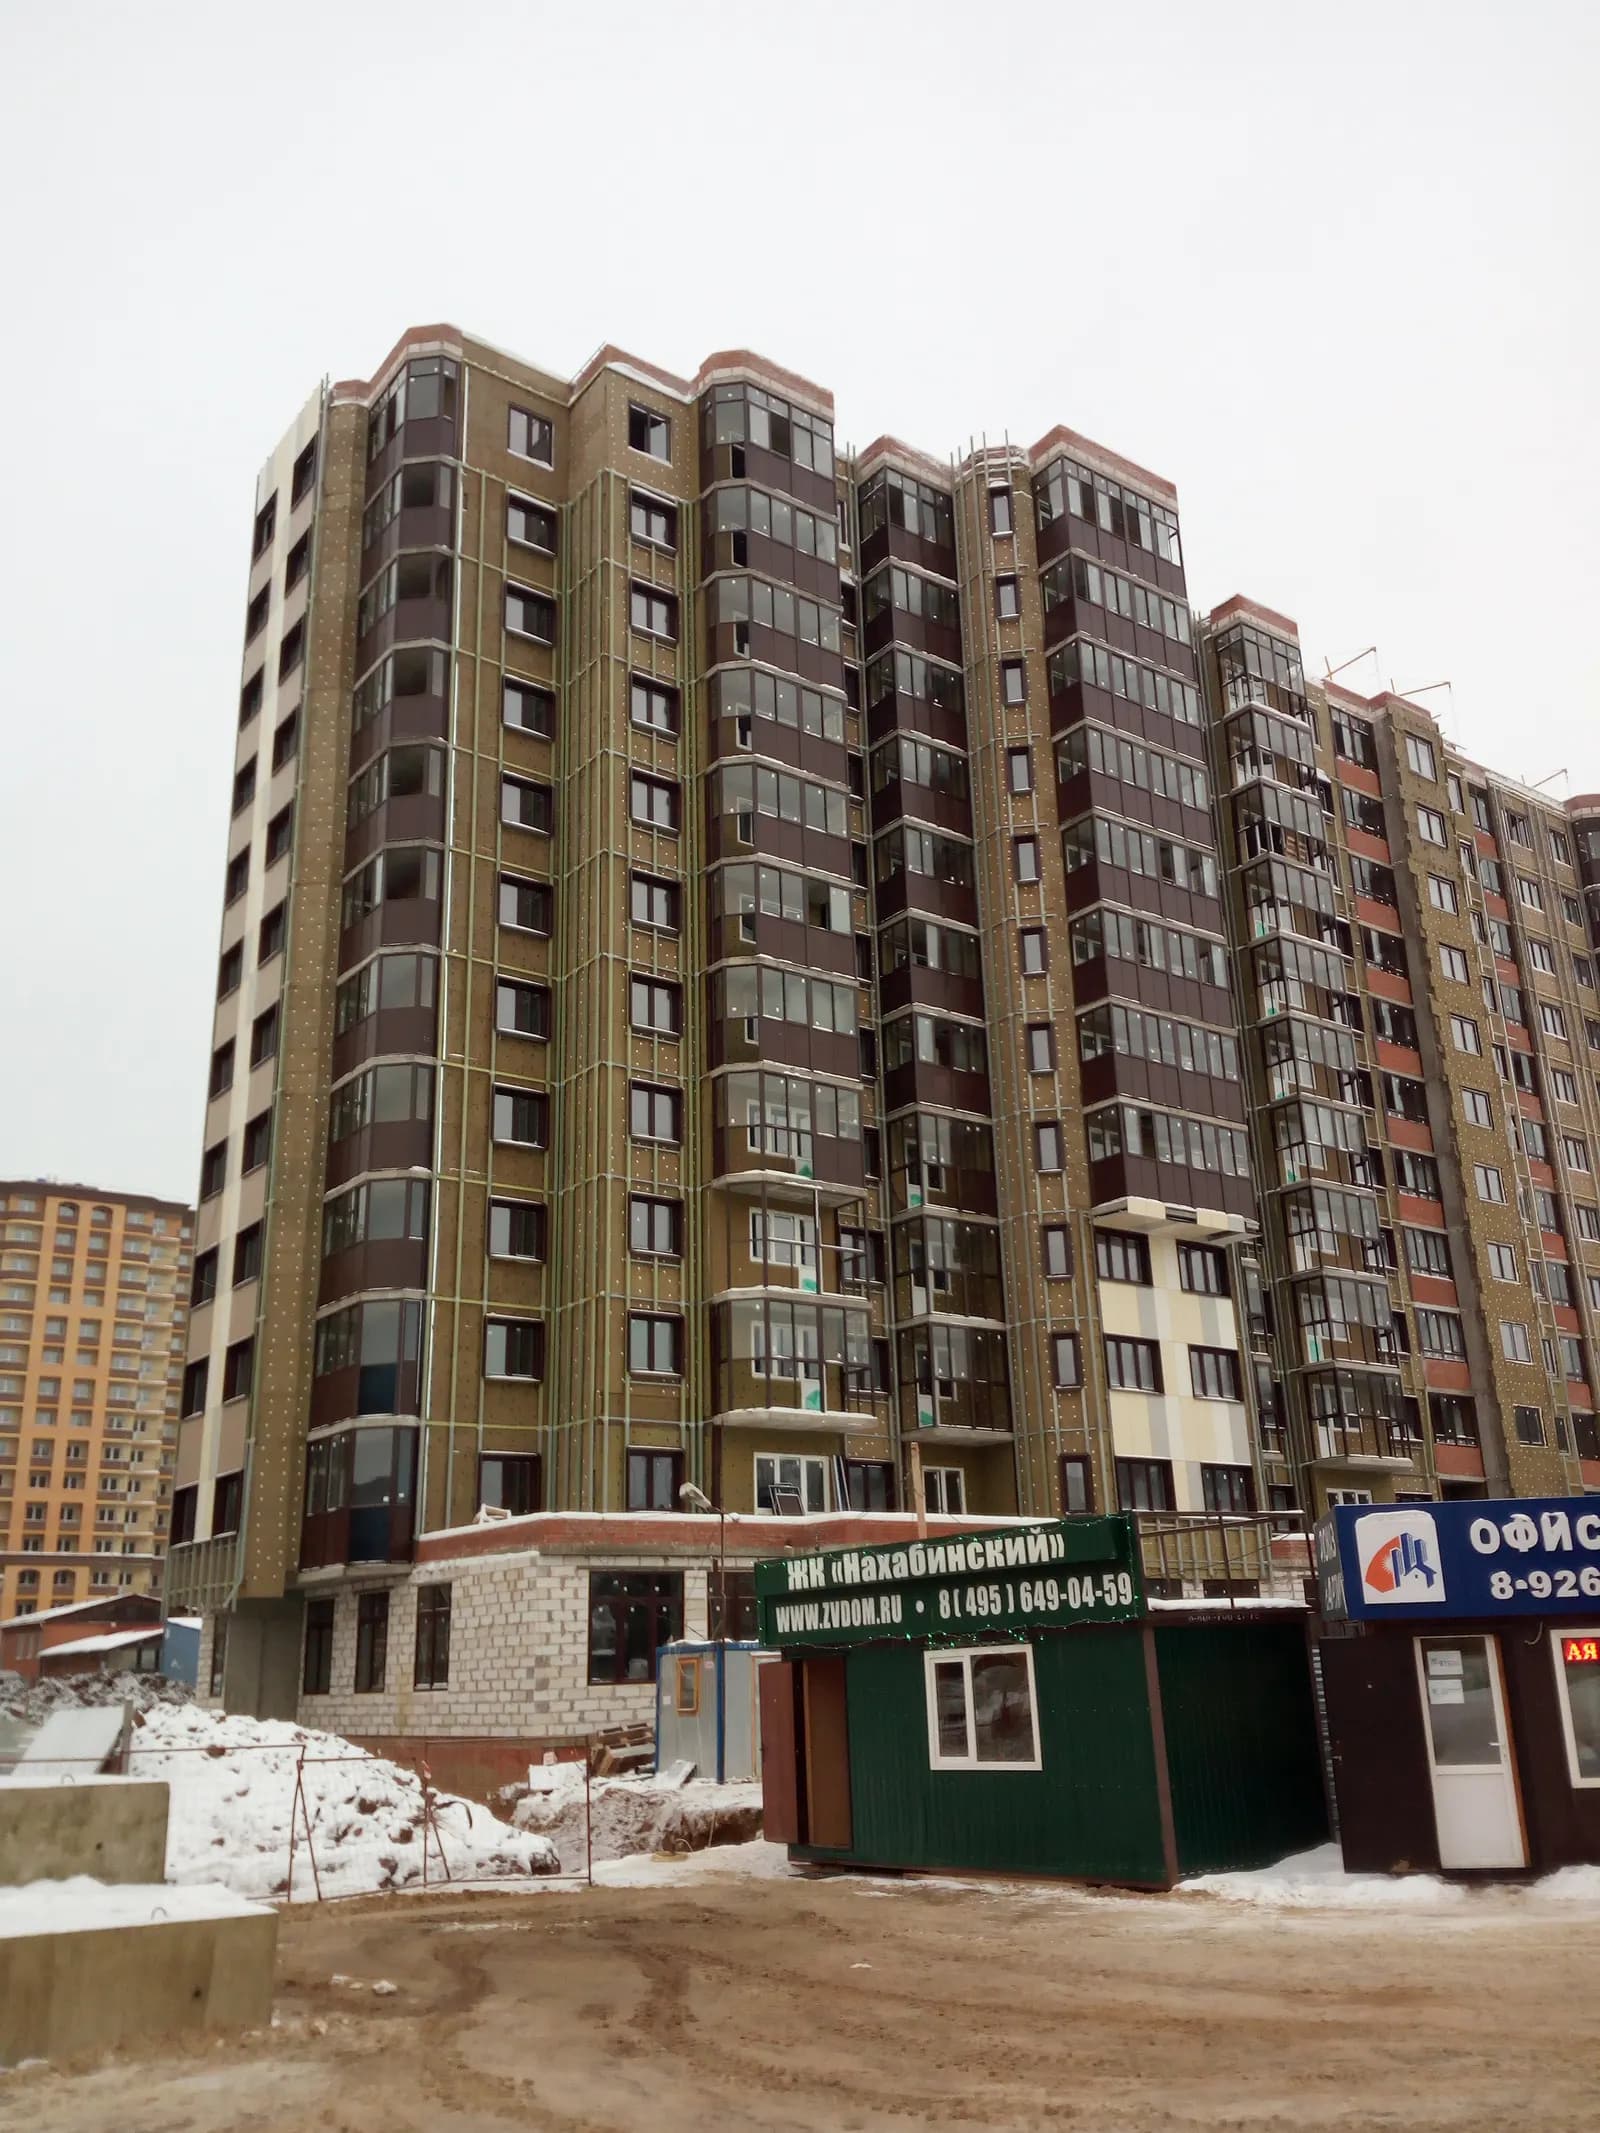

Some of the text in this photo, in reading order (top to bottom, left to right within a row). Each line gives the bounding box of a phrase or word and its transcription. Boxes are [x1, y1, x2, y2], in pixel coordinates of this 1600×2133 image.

[787, 1527, 1064, 1590] ЖК «Нахабинский»
[776, 1594, 902, 1633] WWW.ZVDOM.RU
[1019, 1572, 1132, 1613] 649-04-59
